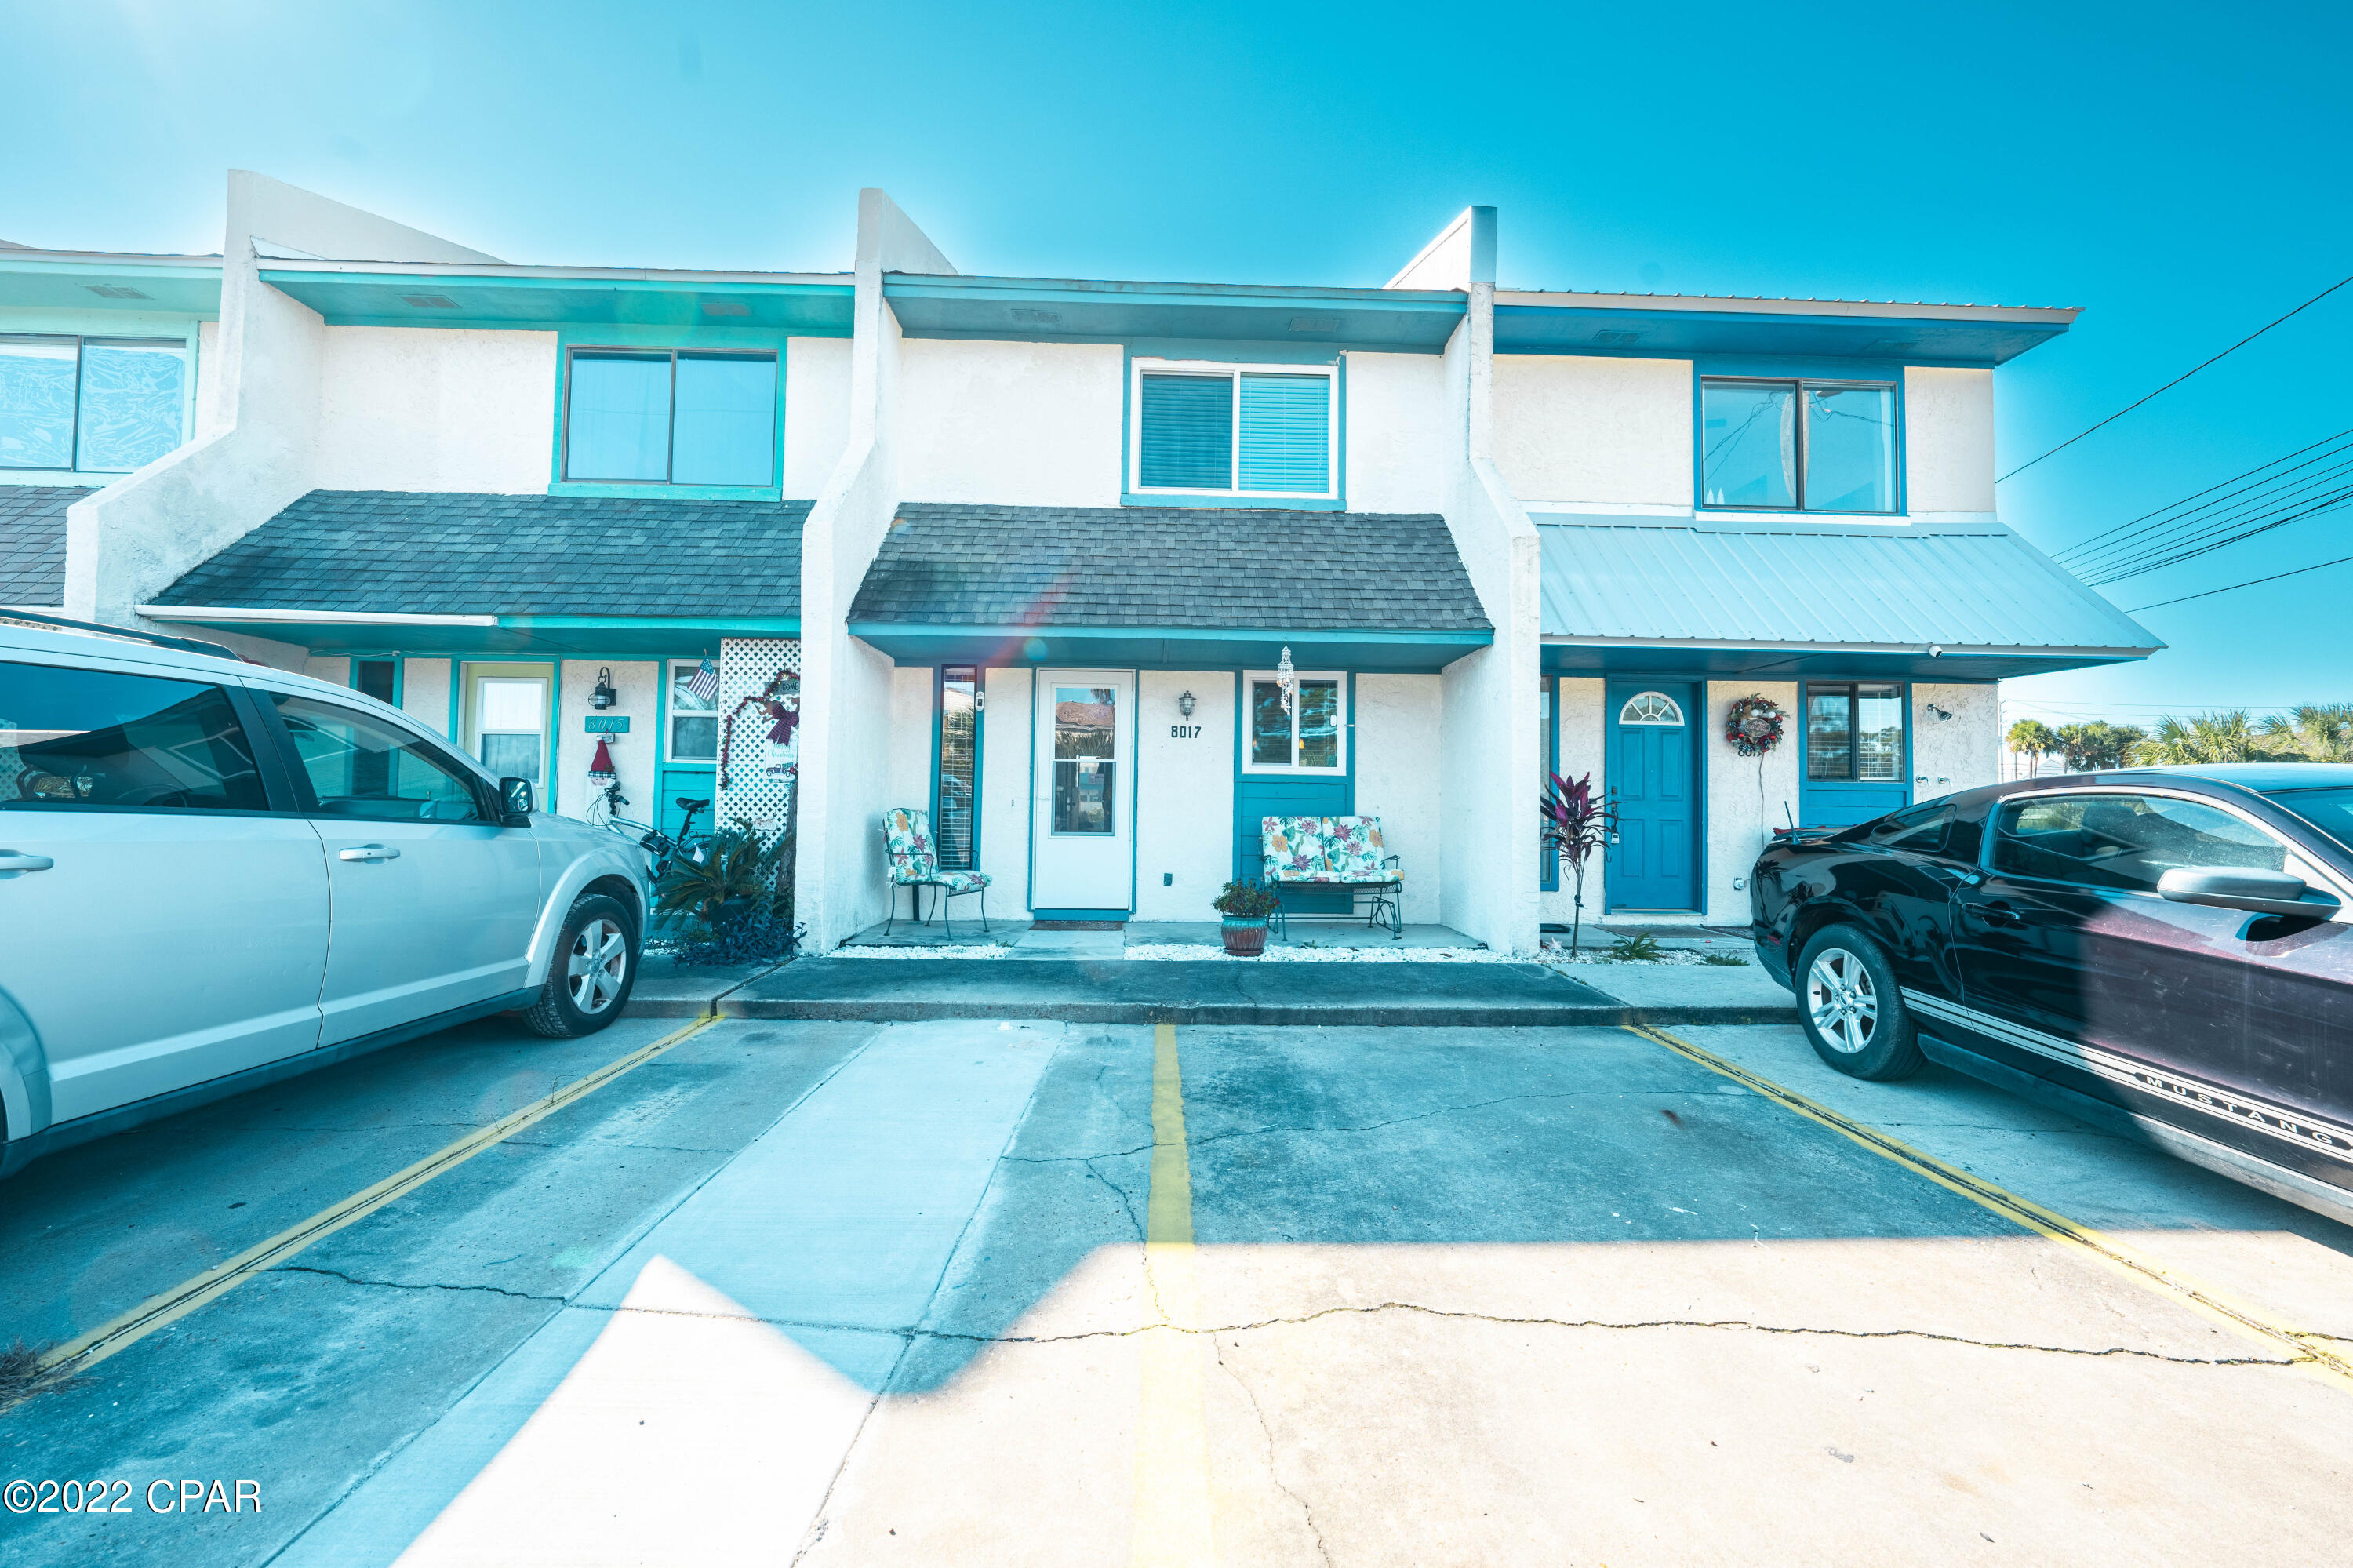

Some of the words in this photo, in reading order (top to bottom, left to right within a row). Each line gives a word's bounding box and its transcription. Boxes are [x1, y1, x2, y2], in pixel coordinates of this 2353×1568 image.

[588, 717, 624, 732] 8015
[1170, 725, 1202, 739] 8017
[2146, 1075, 2333, 1145] MUSTANG
